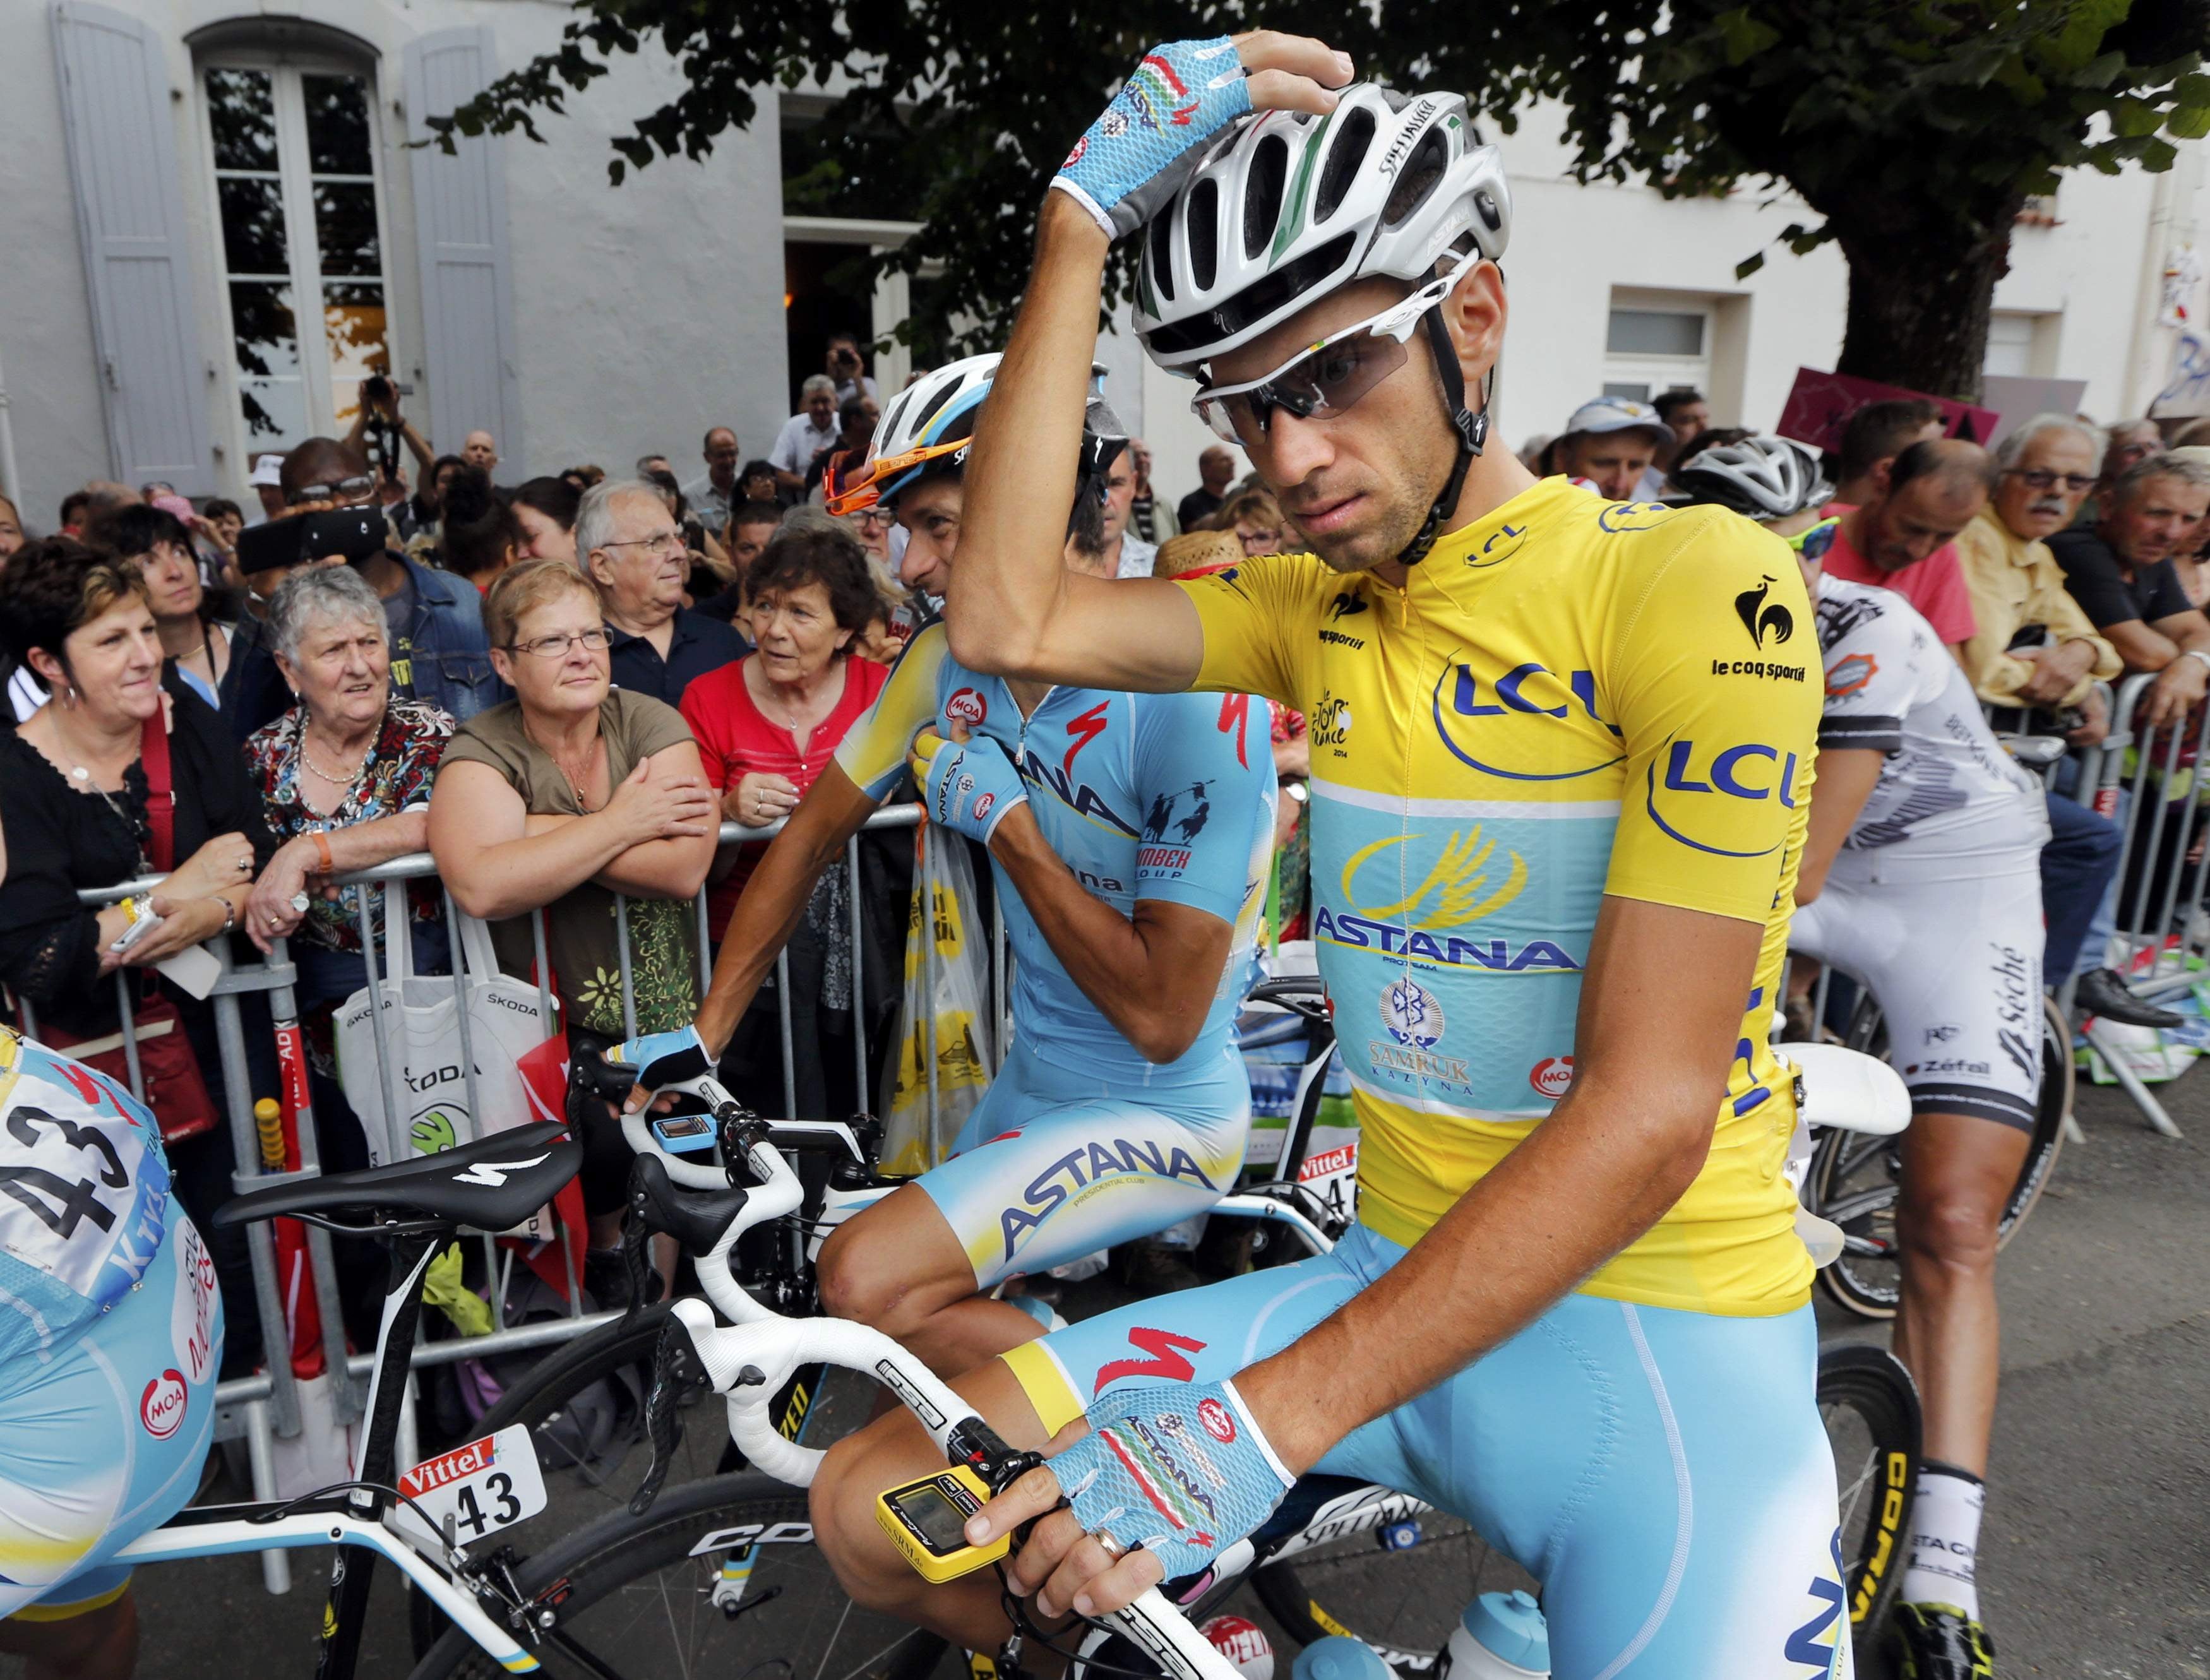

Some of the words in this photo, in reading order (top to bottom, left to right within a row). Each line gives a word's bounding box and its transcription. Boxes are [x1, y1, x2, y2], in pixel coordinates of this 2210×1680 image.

[1712, 659, 1729, 677] le
[1733, 661, 1765, 679] coq
[1767, 664, 1807, 682] sportif
[952, 697, 980, 718] MOA
[1334, 748, 1348, 758] 2014
[939, 749, 964, 823] ASTANA
[1024, 749, 1141, 838] NA
[1314, 905, 1584, 972] ASTANA
[487, 992, 538, 1017] ŠKODA
[404, 1064, 482, 1093] KODA
[1370, 1044, 1471, 1083] SAMRUK
[1541, 1071, 1571, 1085] MO
[1372, 1066, 1473, 1096] KAZYNA
[0, 1105, 129, 1239] 43
[1299, 1149, 1349, 1179] Vittel
[1001, 1139, 1220, 1263] ASTANA
[1073, 1179, 1125, 1207] PRESIDENTIAL
[151, 1388, 183, 1422] MOA
[403, 1442, 487, 1494] Vittel
[1127, 1415, 1215, 1522] ASTANA
[457, 1472, 521, 1536] 43
